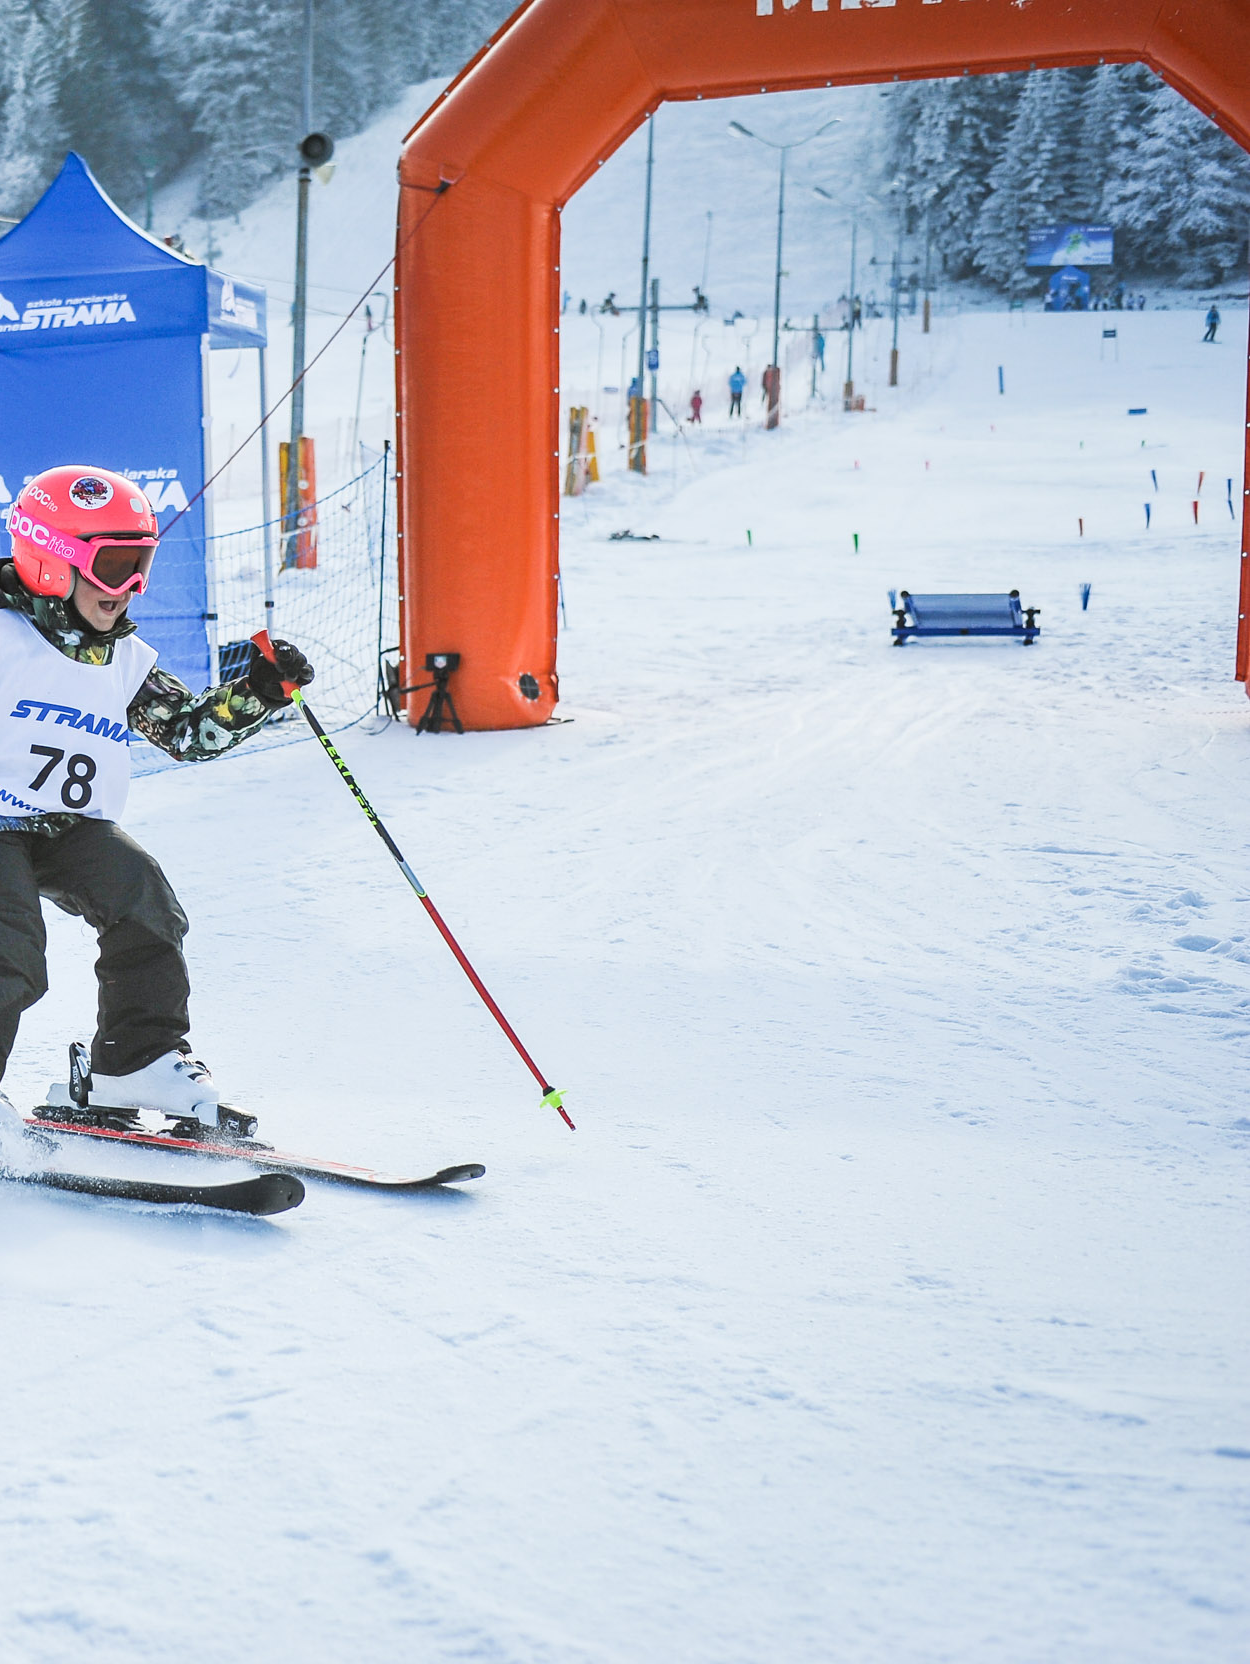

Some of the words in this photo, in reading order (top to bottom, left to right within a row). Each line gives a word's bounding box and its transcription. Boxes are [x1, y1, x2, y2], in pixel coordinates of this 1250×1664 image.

[21, 301, 137, 331] STRAMA
[65, 293, 128, 306] narciarska
[9, 699, 131, 747] STRAMA
[28, 744, 97, 809] 78
